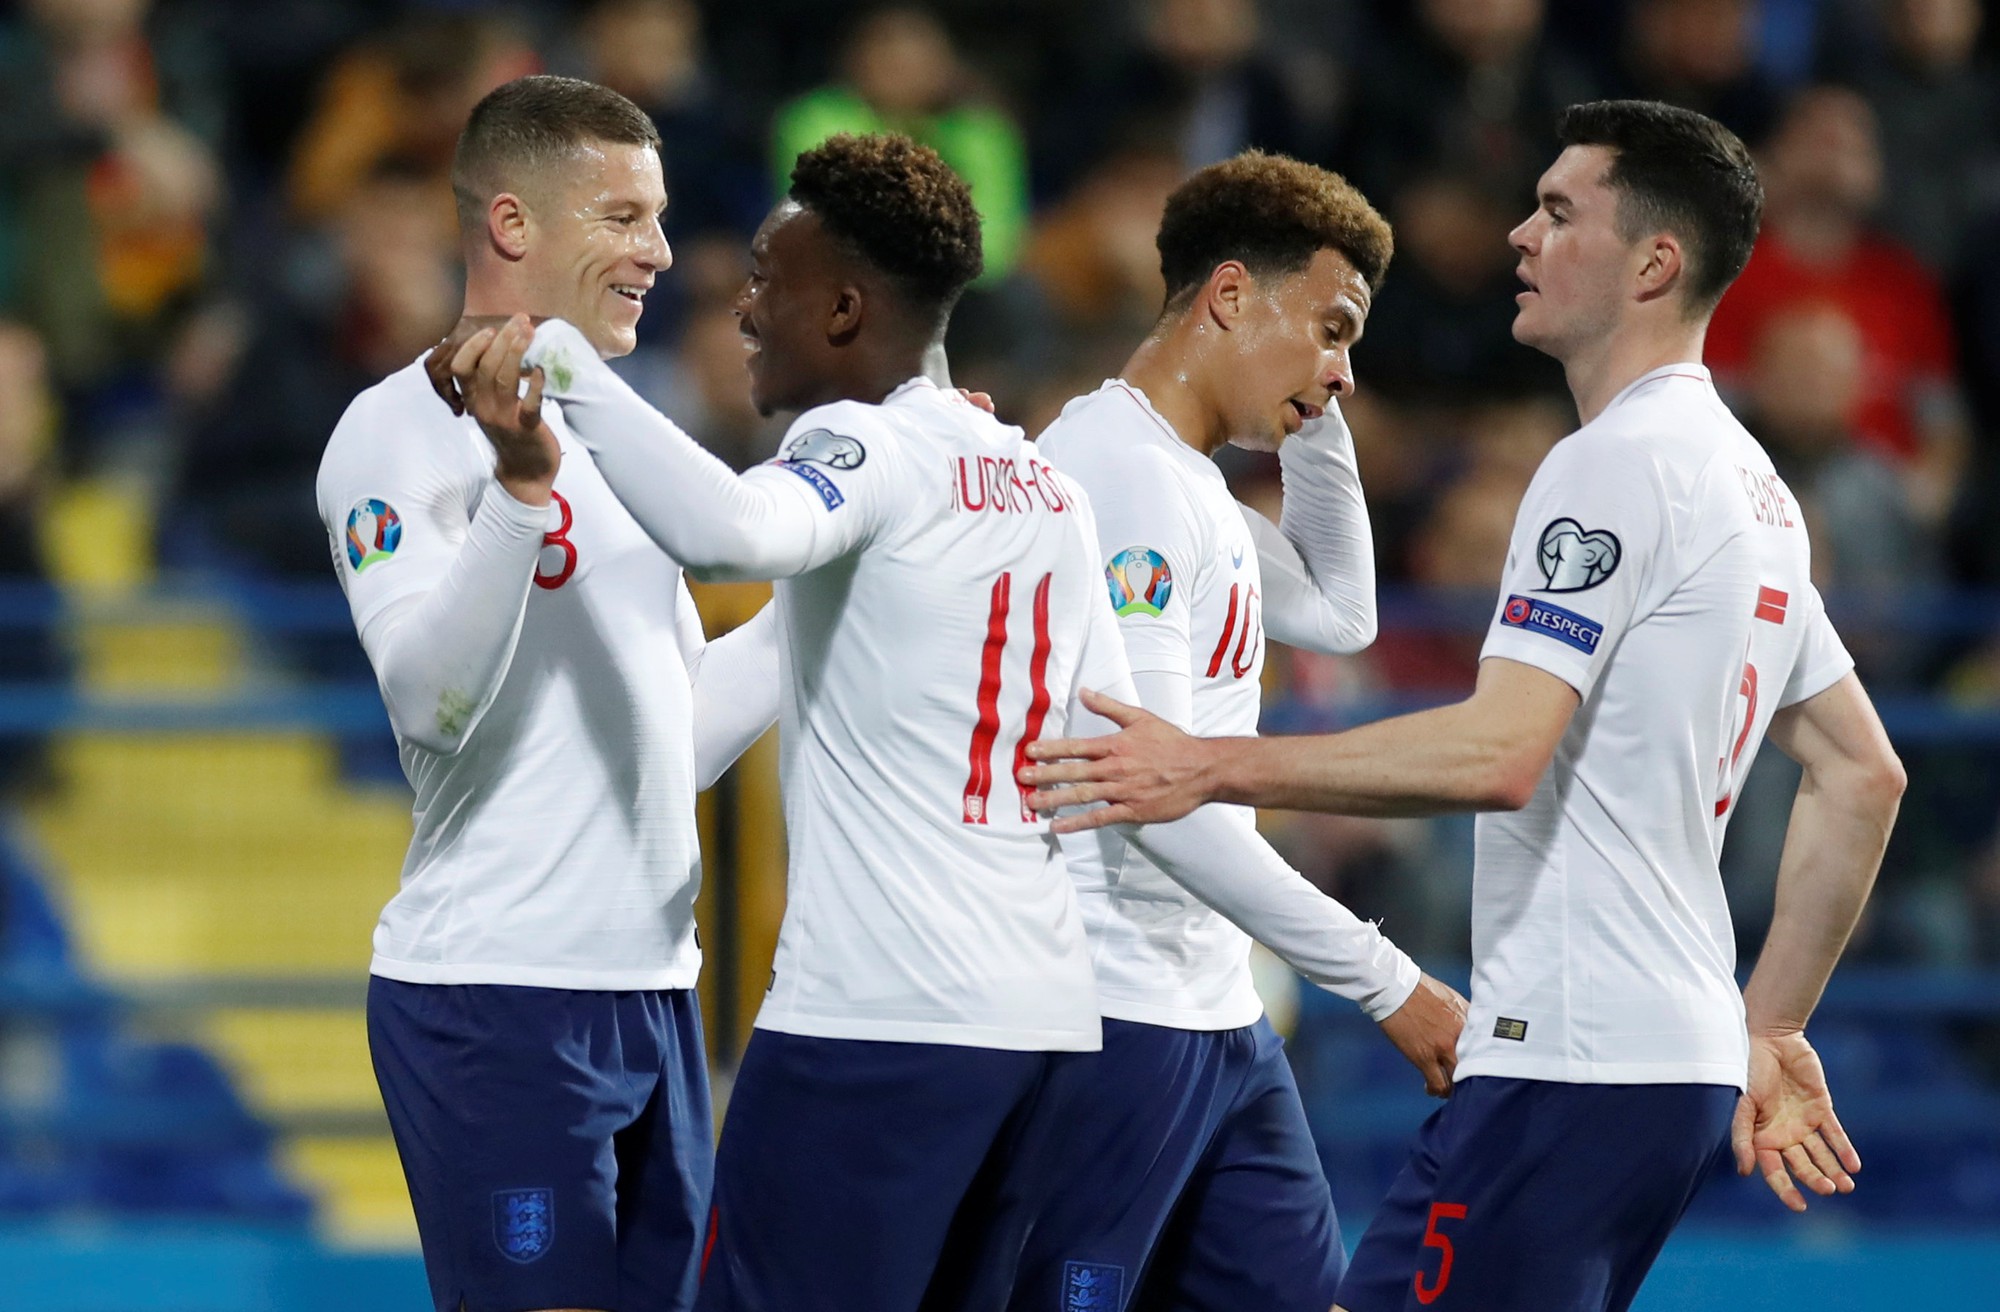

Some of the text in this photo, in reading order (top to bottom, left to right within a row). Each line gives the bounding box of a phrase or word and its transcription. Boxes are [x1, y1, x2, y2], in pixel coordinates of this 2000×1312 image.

[782, 463, 841, 506] ESPECT
[1734, 464, 1793, 528] EANE
[534, 490, 577, 589] 8
[1206, 582, 1260, 679] 10
[1530, 608, 1600, 645] RESPECT
[963, 572, 1052, 823] 11
[1414, 1202, 1468, 1304] 5
